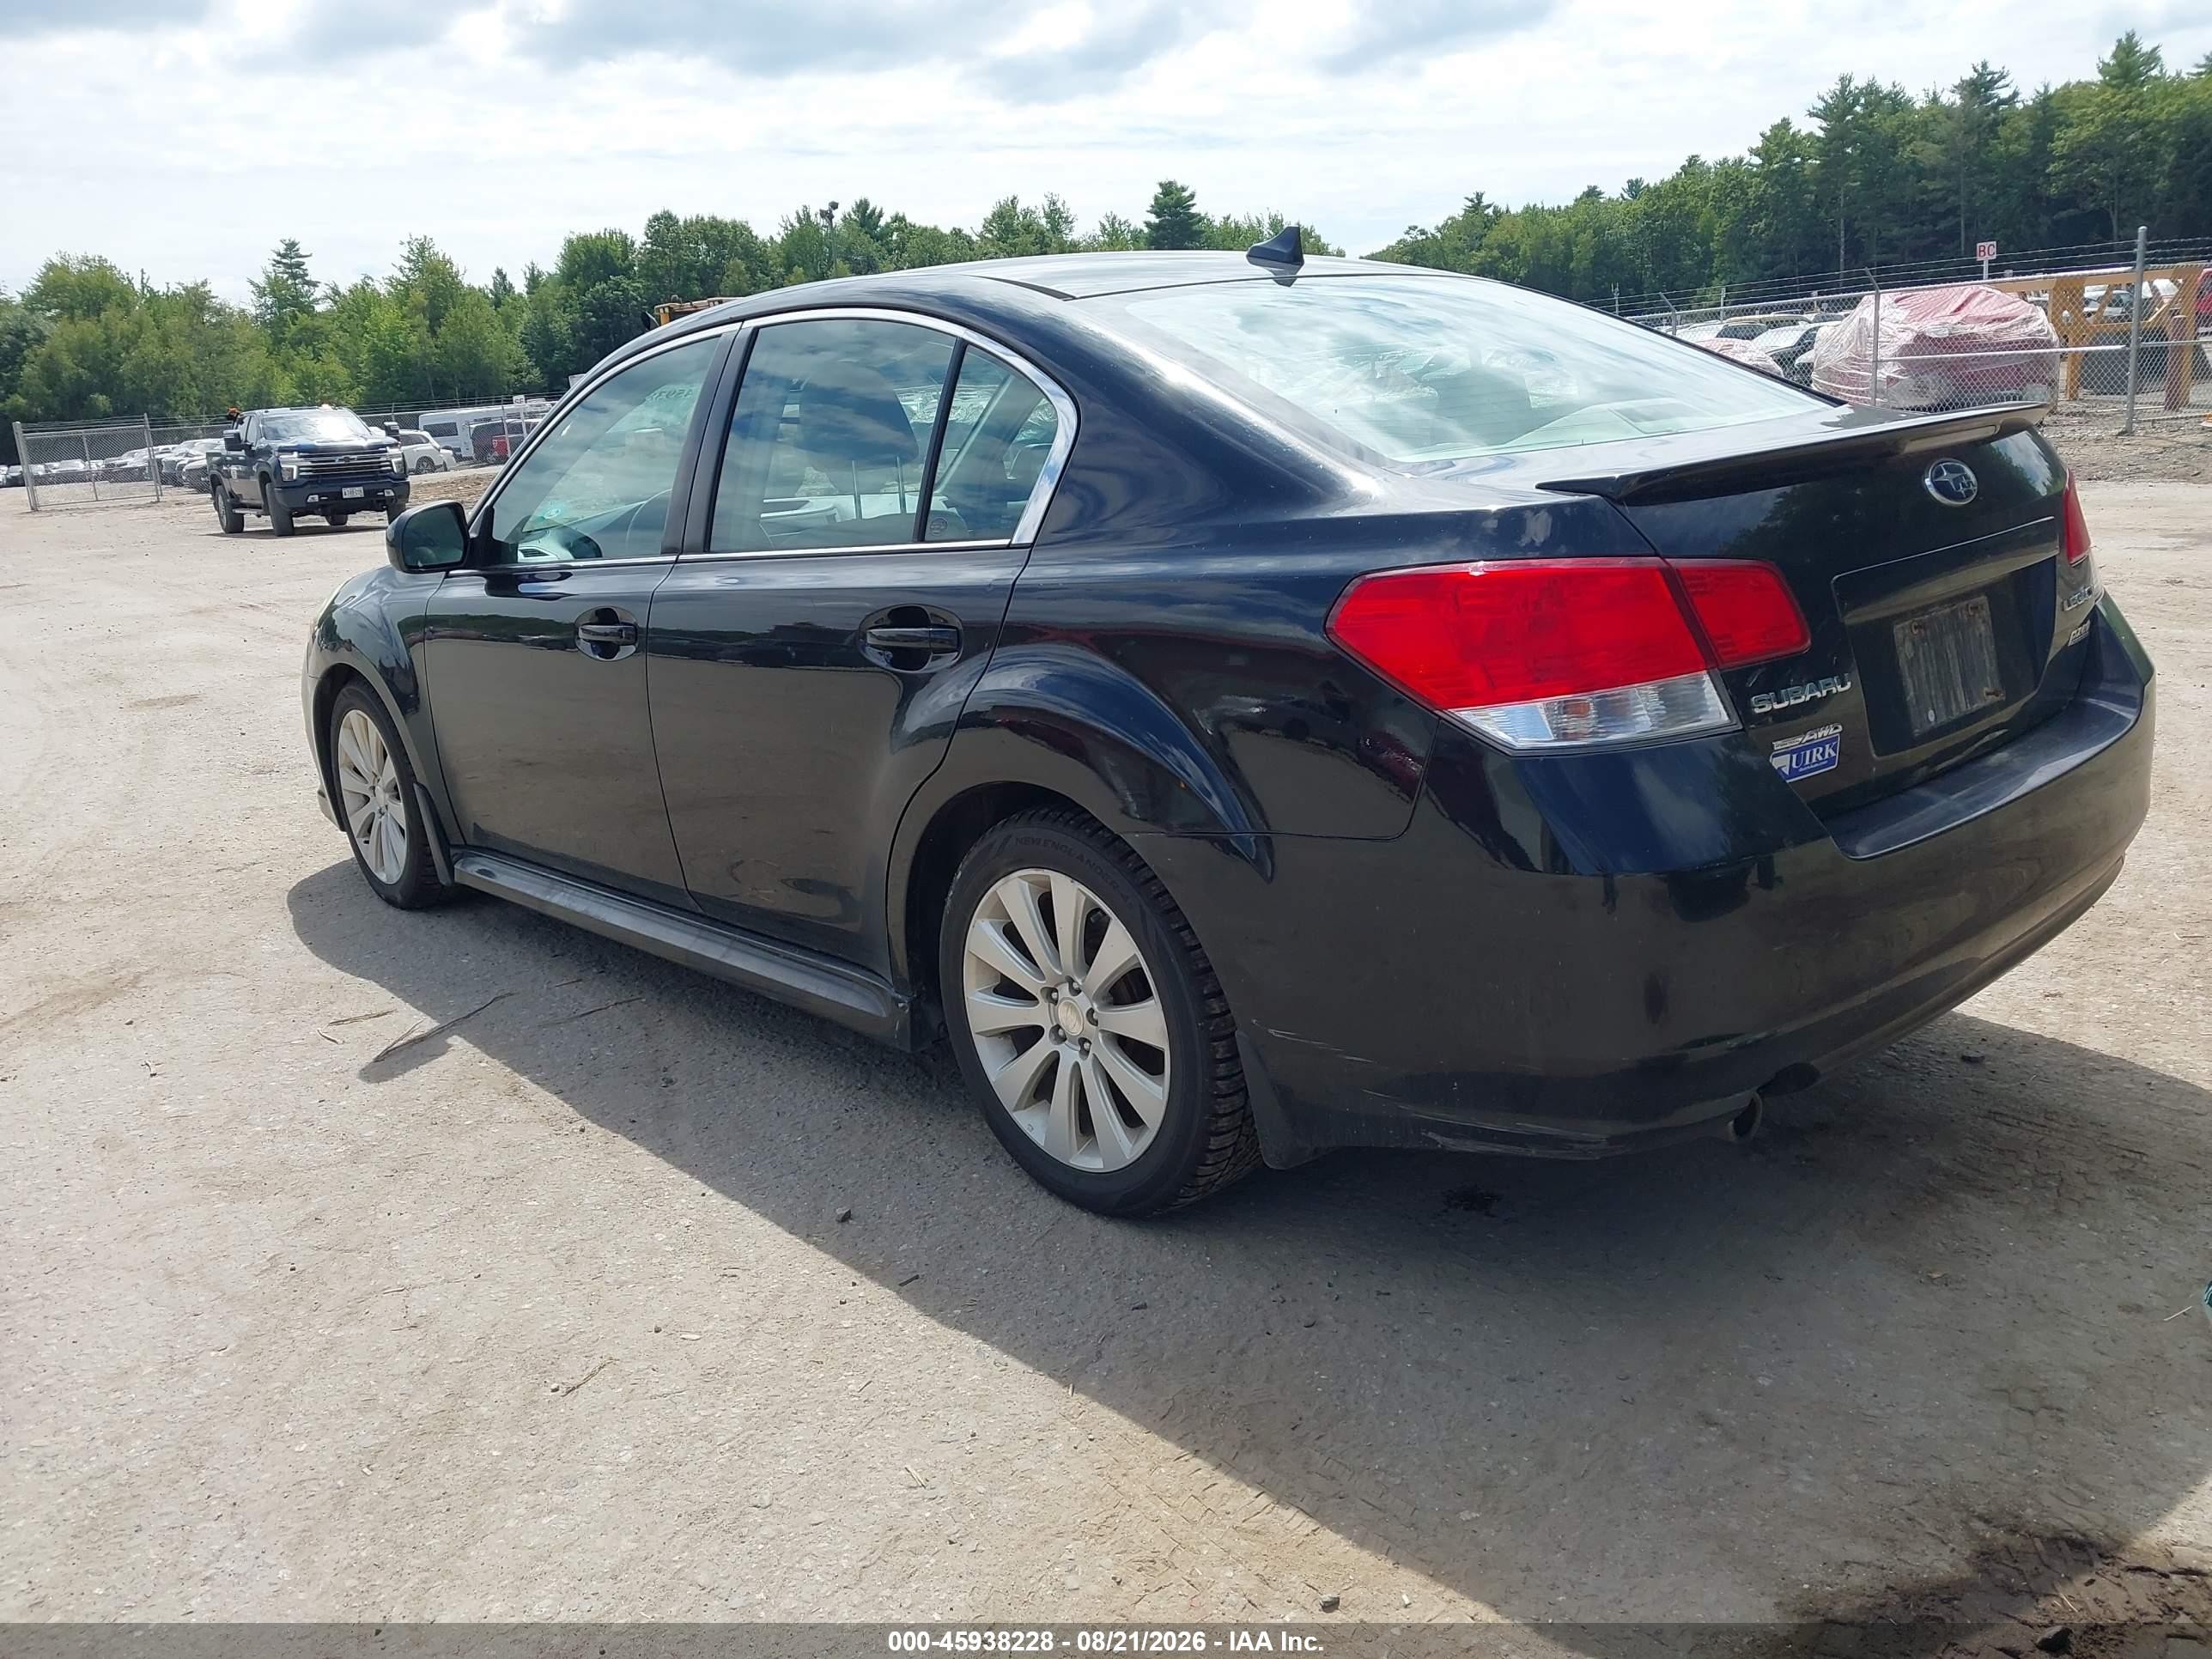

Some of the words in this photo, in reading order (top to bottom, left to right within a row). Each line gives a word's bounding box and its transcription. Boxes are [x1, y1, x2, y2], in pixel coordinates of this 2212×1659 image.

[1978, 244, 1996, 258] BC
[1751, 672, 1852, 714] SUBARU
[1802, 722, 1844, 744] AWD
